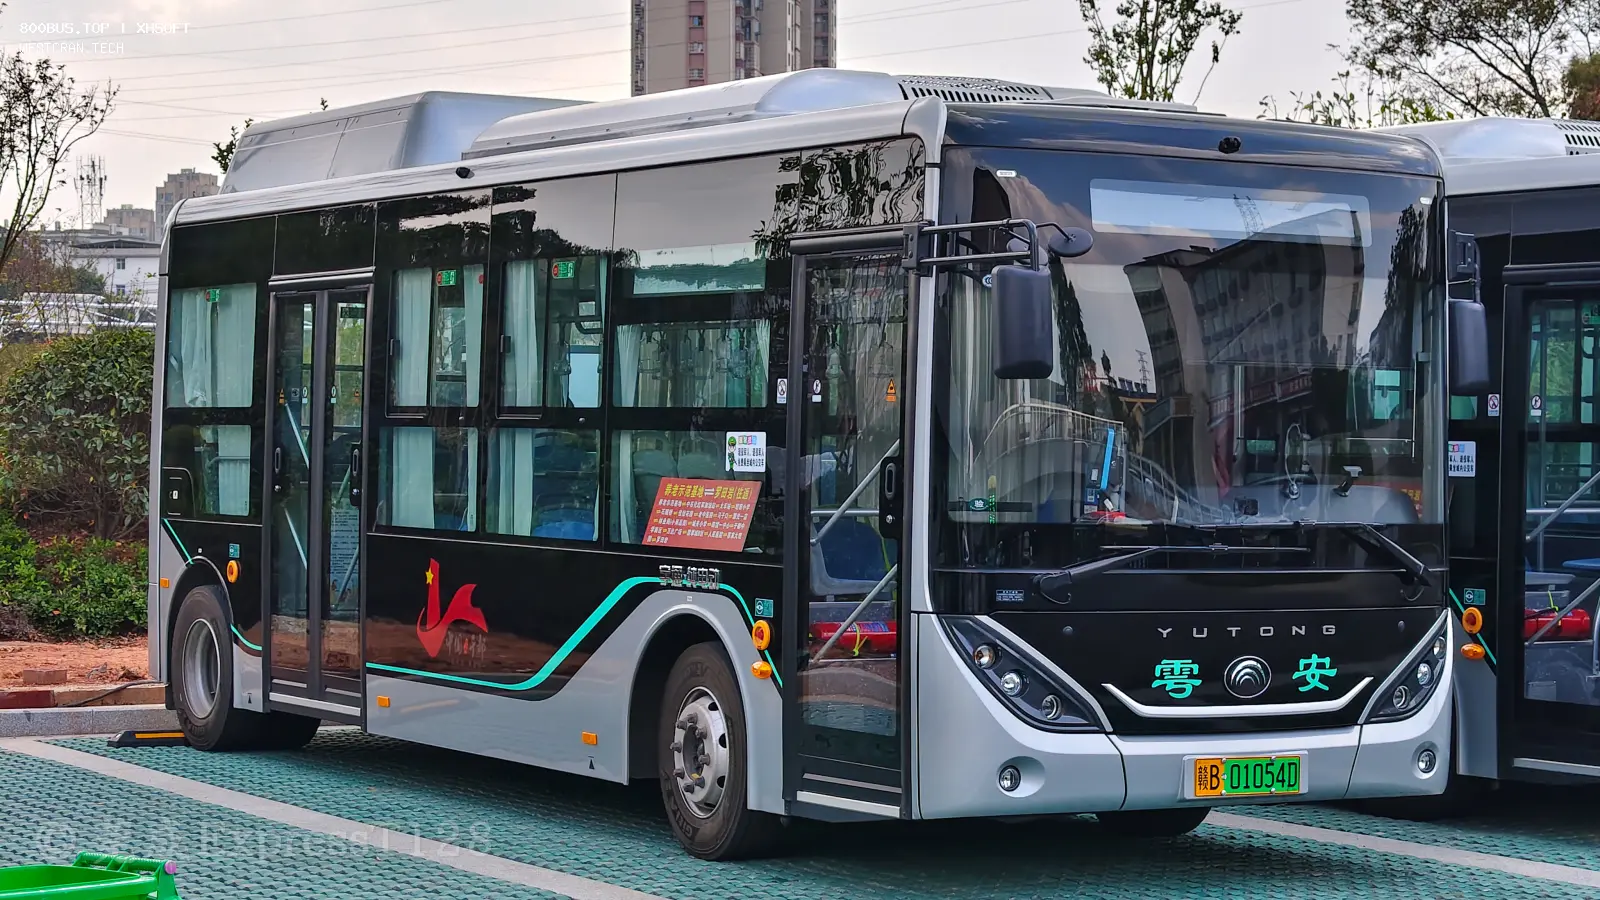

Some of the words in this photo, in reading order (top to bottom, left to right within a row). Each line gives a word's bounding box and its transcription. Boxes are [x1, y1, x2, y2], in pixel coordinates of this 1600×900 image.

[664, 483, 704, 497] 养老示范基地
[1157, 625, 1337, 638] YUTONG
[1292, 653, 1338, 692] 安
